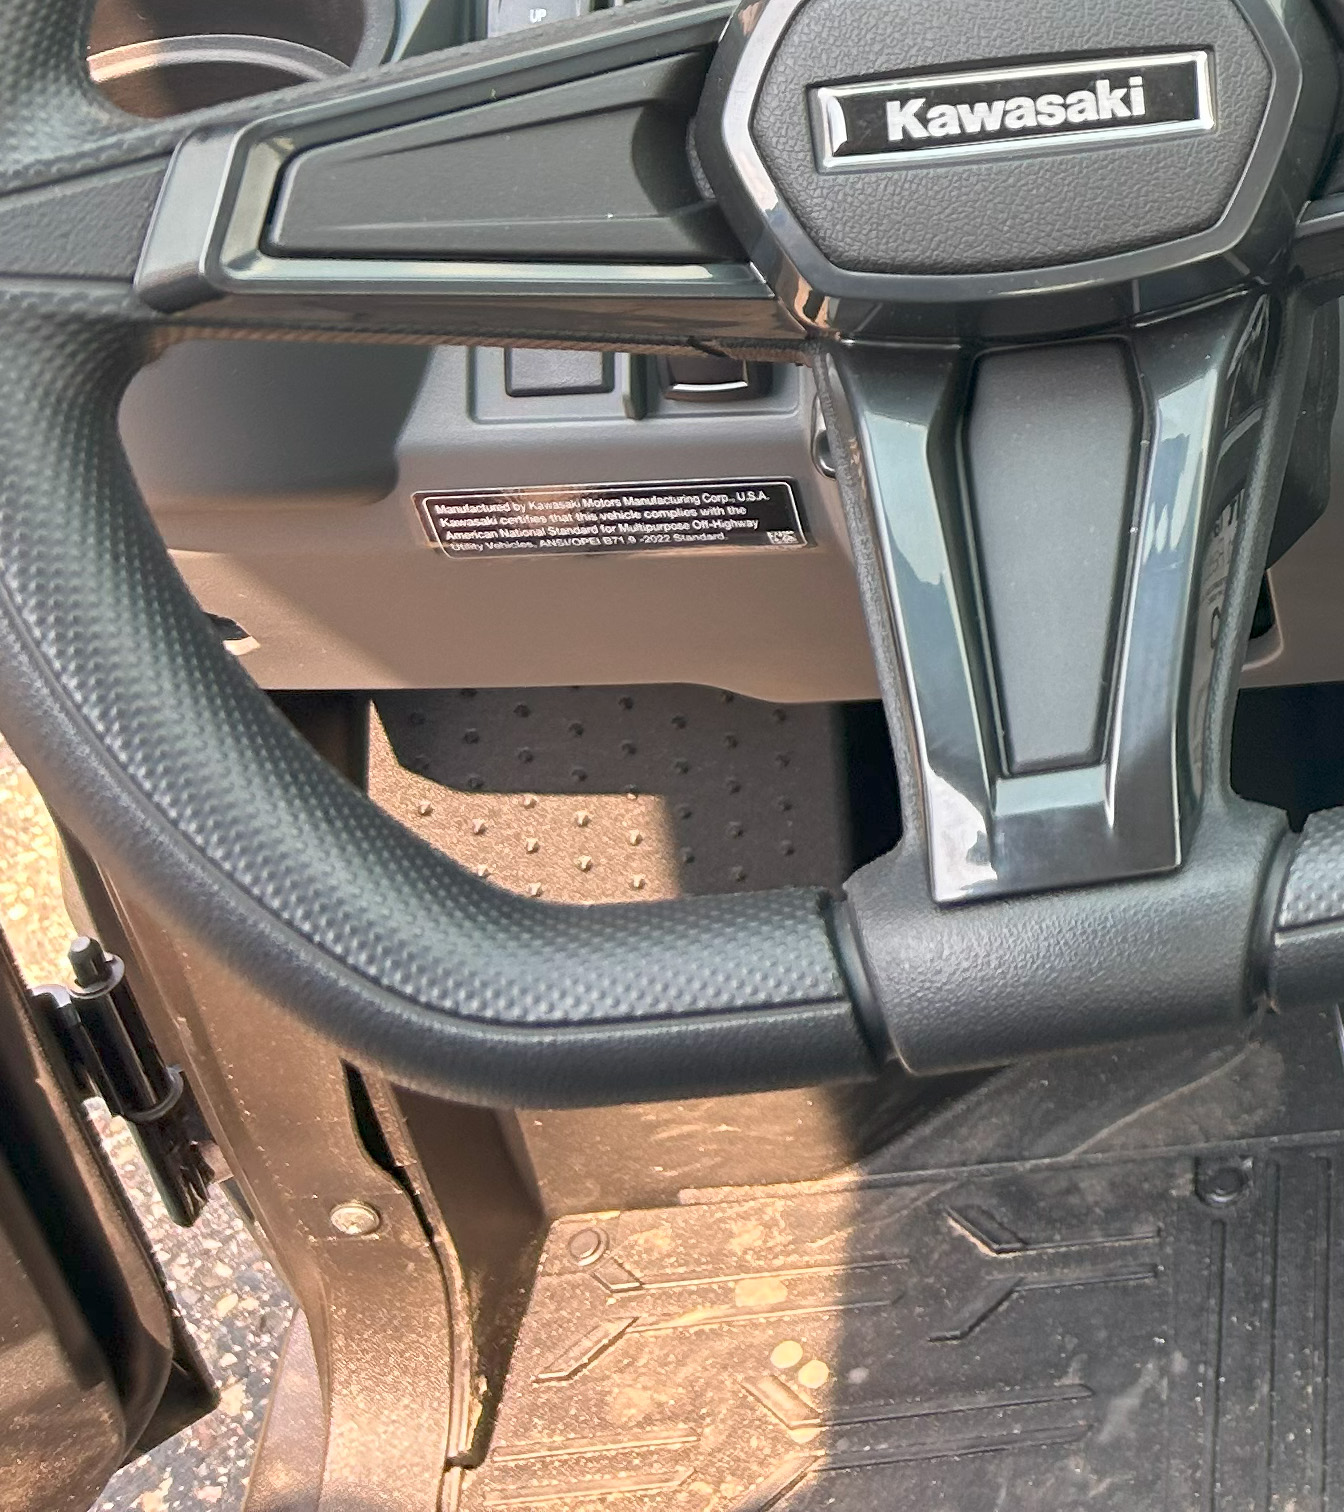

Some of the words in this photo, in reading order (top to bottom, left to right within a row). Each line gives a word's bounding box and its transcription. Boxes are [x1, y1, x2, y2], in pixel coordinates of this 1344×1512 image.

[530, 8, 547, 23] UP
[885, 76, 1146, 143] Kawasaki
[434, 503, 511, 515] Manufactured
[511, 501, 526, 513] by
[528, 499, 580, 511] Kawasaki
[582, 496, 622, 508] Motors
[623, 494, 701, 507] Manufacturing
[736, 490, 770, 502] U.S.A.
[439, 515, 499, 528] Kawasaki
[499, 513, 547, 525] certifies
[548, 512, 573, 524] that
[576, 511, 598, 522] this
[599, 509, 642, 521] vehicle
[643, 506, 698, 519] complies
[700, 505, 725, 517] with
[727, 505, 747, 516] the
[446, 529, 499, 541] American
[499, 527, 547, 539] National
[547, 525, 599, 537] Standard
[600, 523, 616, 535] for
[618, 520, 690, 534] Multipurpose
[691, 518, 759, 531] Off-Highway
[450, 542, 484, 553] Utility
[673, 532, 729, 543] Standard.
